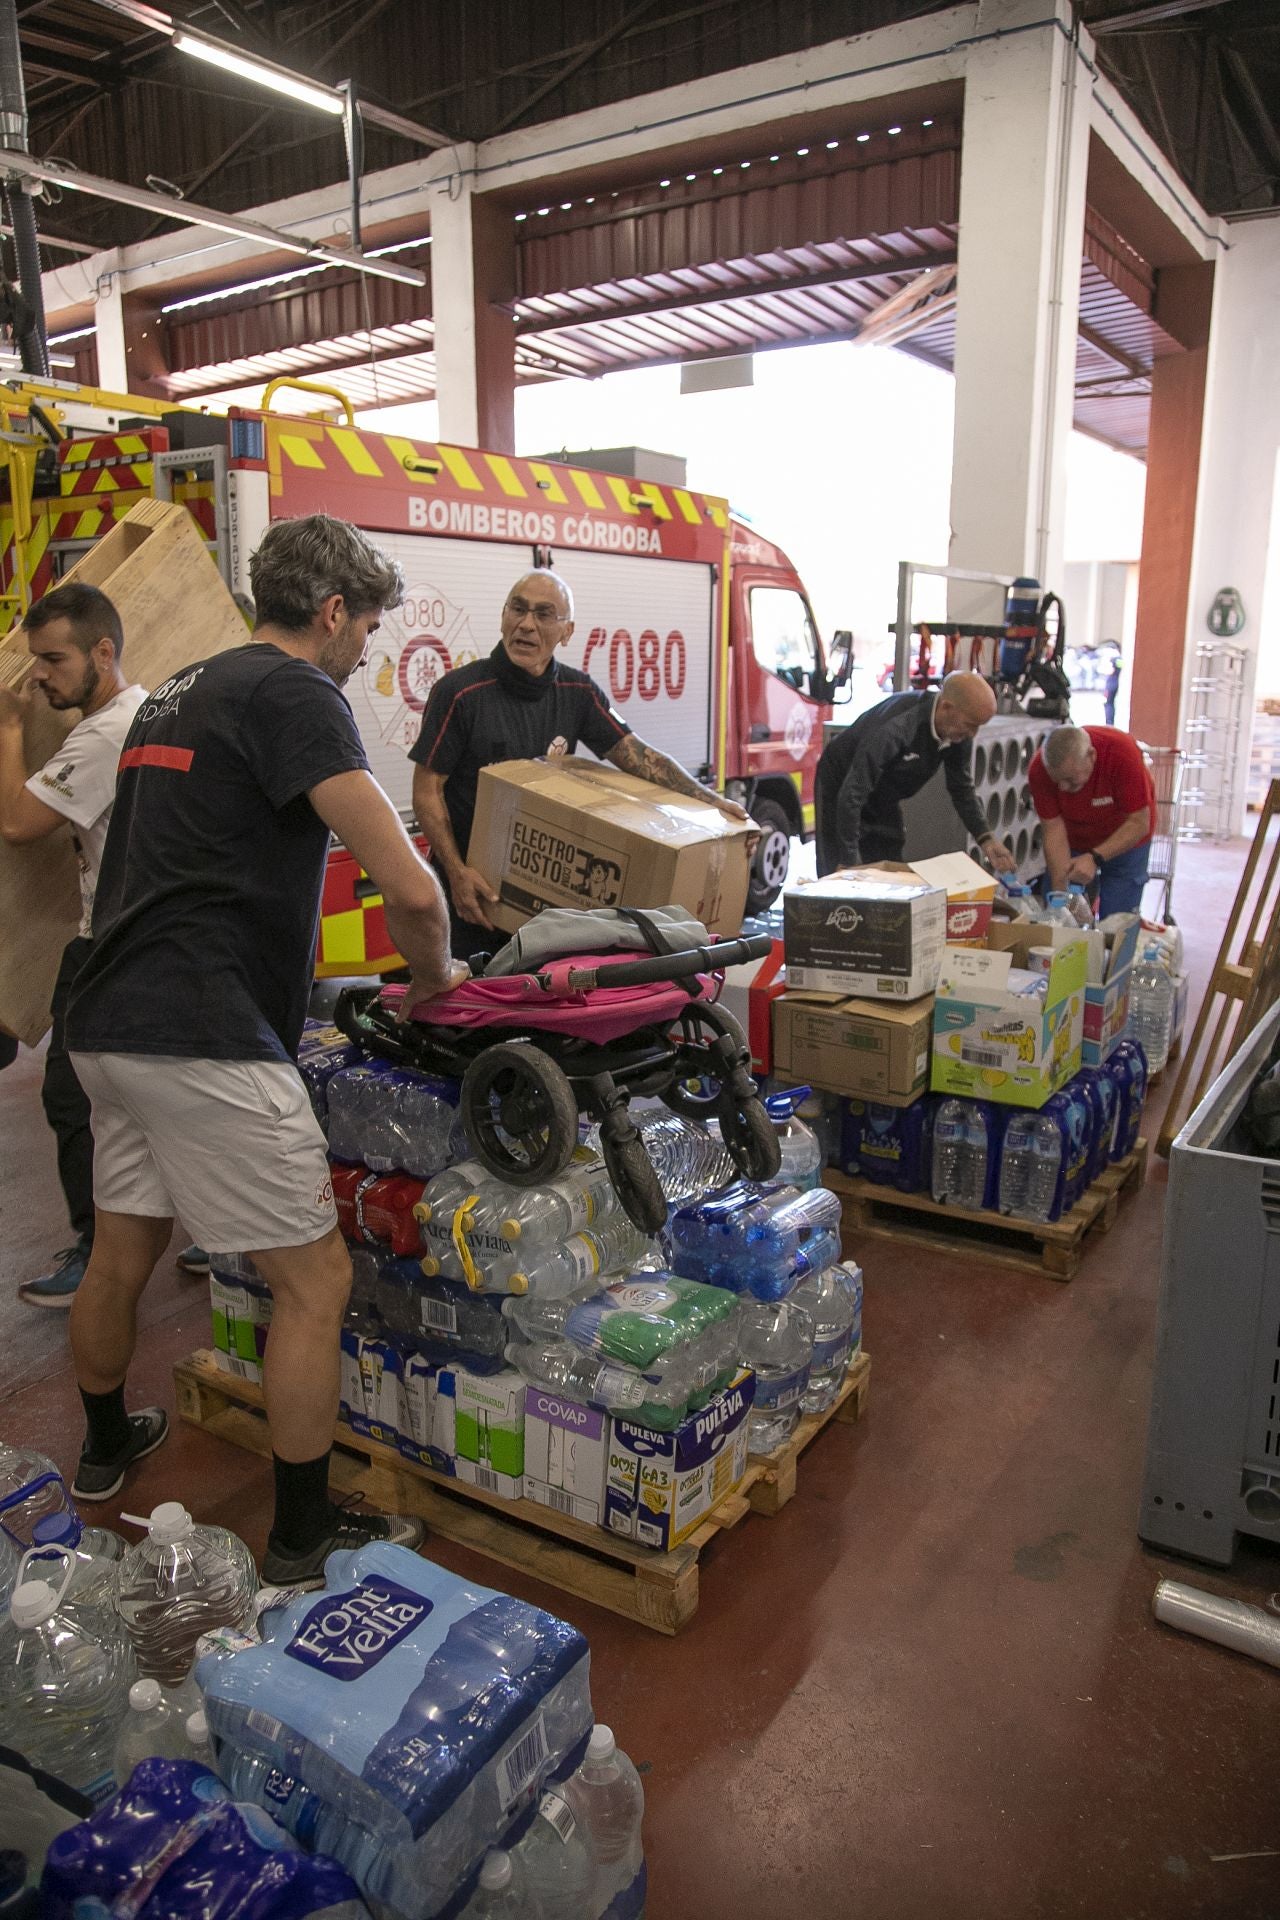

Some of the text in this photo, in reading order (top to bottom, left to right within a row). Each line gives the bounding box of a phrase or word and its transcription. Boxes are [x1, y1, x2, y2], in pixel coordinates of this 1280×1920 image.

[408, 496, 662, 553] BOMBEROS CÓRDOBA
[403, 599, 445, 628] 080
[608, 628, 686, 703] 080
[510, 842, 562, 883] COSTO
[513, 822, 576, 864] ELECTRO
[537, 1397, 587, 1426] COVAP
[621, 1421, 666, 1446] PULEVA
[695, 1390, 744, 1444] PULEVA
[294, 1588, 390, 1658] Font
[322, 1603, 424, 1664] Vella
